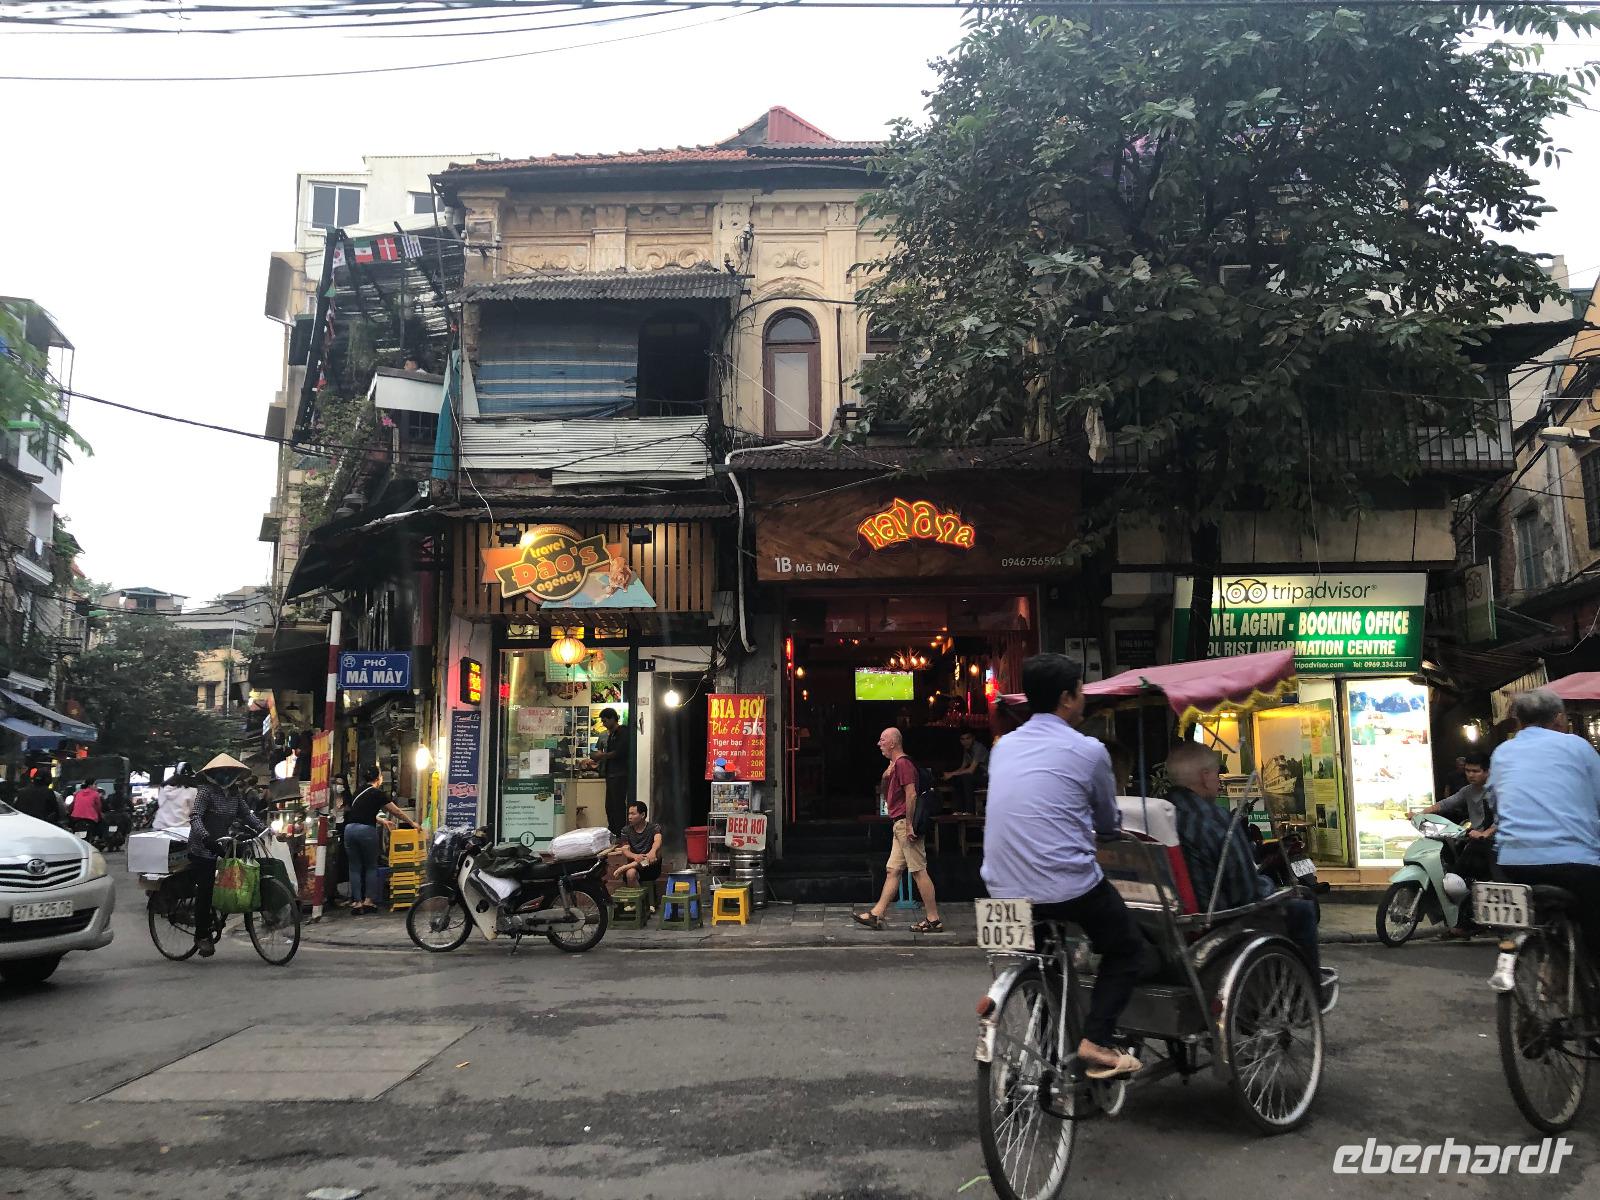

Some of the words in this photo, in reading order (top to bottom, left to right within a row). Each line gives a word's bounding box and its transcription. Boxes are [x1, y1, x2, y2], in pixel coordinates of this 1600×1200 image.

[857, 498, 976, 551] Havana
[530, 538, 566, 558] travel
[775, 557, 792, 573] 1B
[536, 570, 582, 592] agency
[1240, 612, 1286, 637] AGENT
[1299, 611, 1361, 636] BOOKING
[1364, 610, 1410, 635] OFFICE
[1207, 641, 1252, 657] OURIST
[1347, 640, 1396, 655] CENTRE
[363, 656, 387, 667] PHỐ
[346, 667, 368, 684] MÃ
[372, 667, 403, 684] MÂY
[711, 699, 736, 719] BIA
[713, 739, 729, 747] Tiger
[713, 749, 729, 757] Tiger
[728, 816, 748, 833] BEER
[986, 903, 1021, 923] 29XL
[982, 925, 1026, 946] 0057
